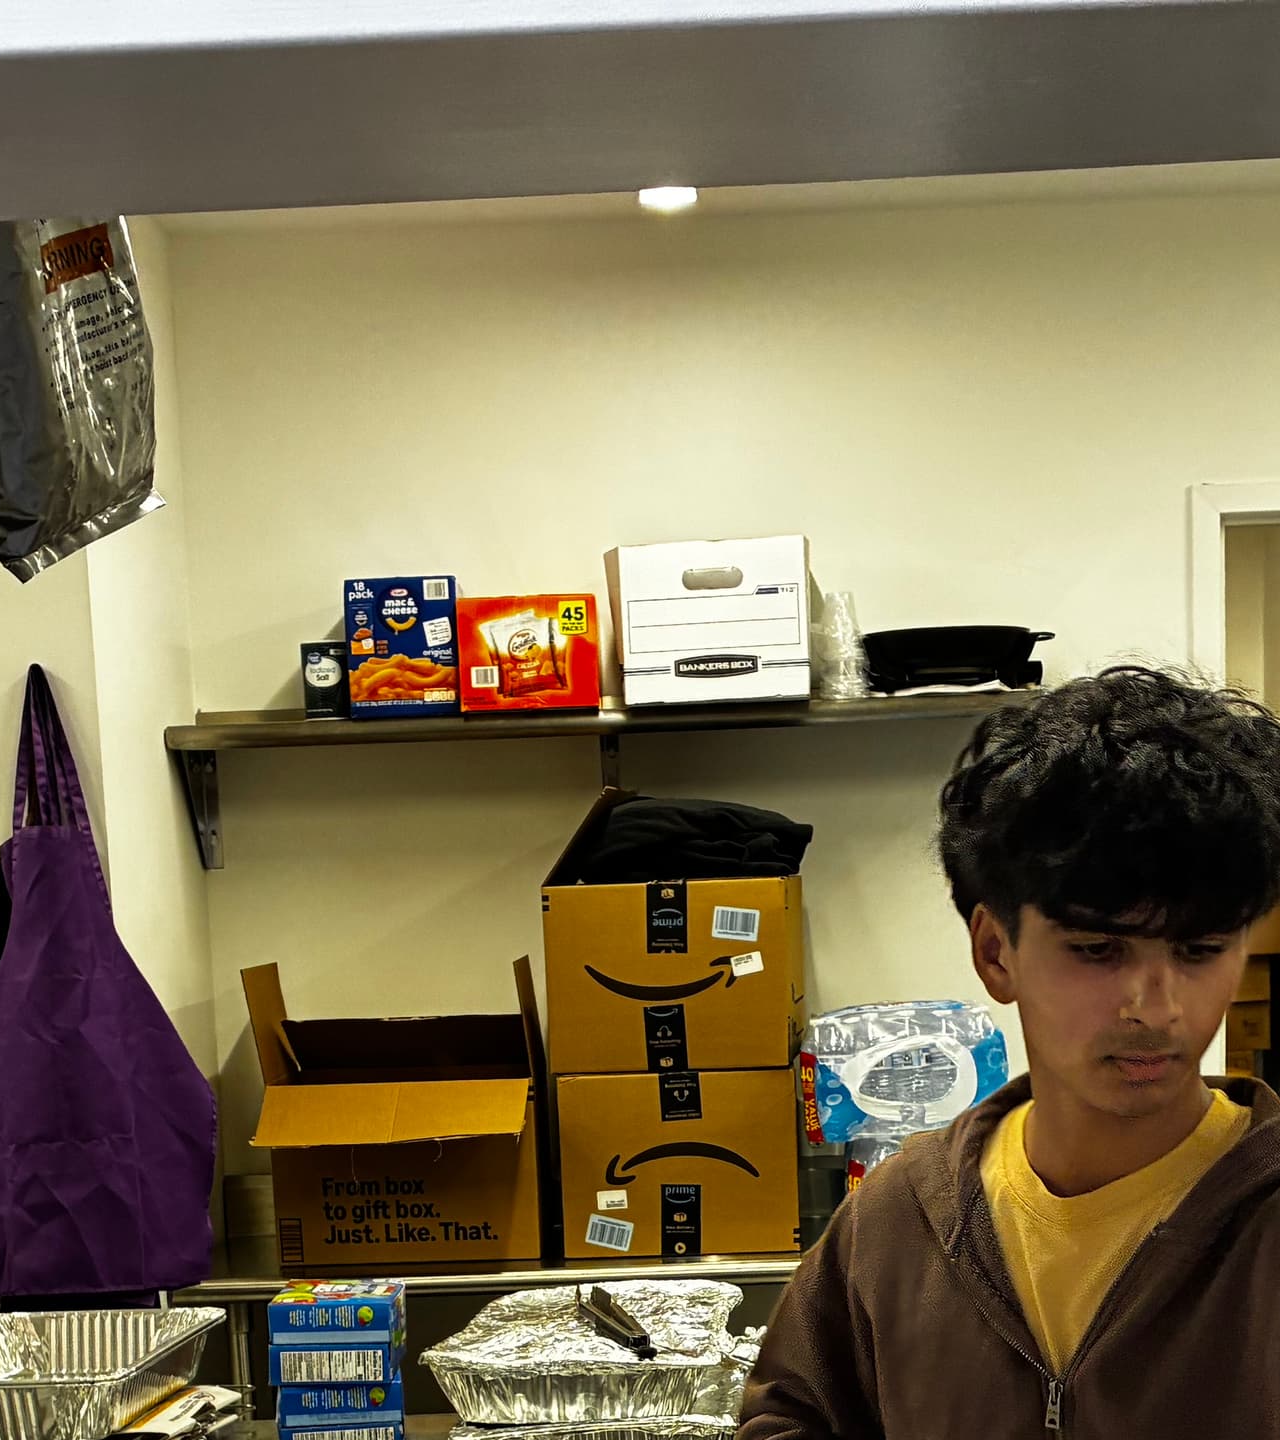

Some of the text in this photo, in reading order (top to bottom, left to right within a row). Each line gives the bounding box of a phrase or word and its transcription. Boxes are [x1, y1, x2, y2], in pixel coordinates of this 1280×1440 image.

[353, 581, 365, 591] 18
[349, 588, 374, 601] pack
[385, 597, 415, 607] mac &
[562, 606, 584, 621] 45
[680, 660, 754, 672] BANKERS BOX
[652, 917, 684, 930] prime
[809, 1098, 821, 1132] VALUE
[321, 1176, 424, 1198] From box
[665, 1185, 695, 1196] prime
[323, 1200, 440, 1223] to gift box.
[324, 1222, 498, 1244] Just. Like. That.
